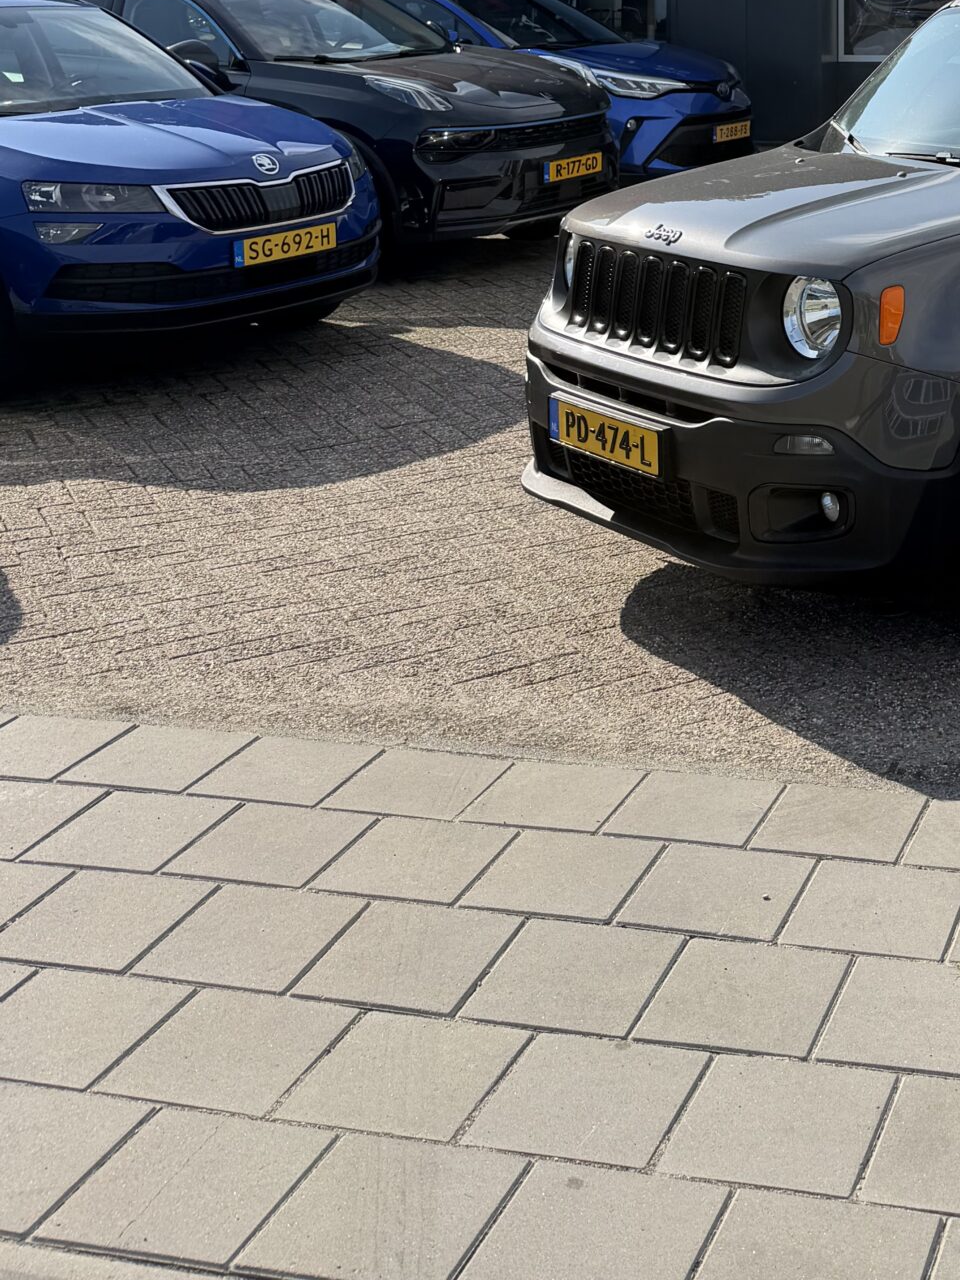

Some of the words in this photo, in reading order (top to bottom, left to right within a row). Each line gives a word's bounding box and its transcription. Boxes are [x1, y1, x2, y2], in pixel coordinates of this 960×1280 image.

[555, 156, 598, 178] R-177-GD
[248, 227, 330, 260] SG-692-H
[644, 223, 683, 247] Jeep
[565, 409, 652, 468] PD-474-L
